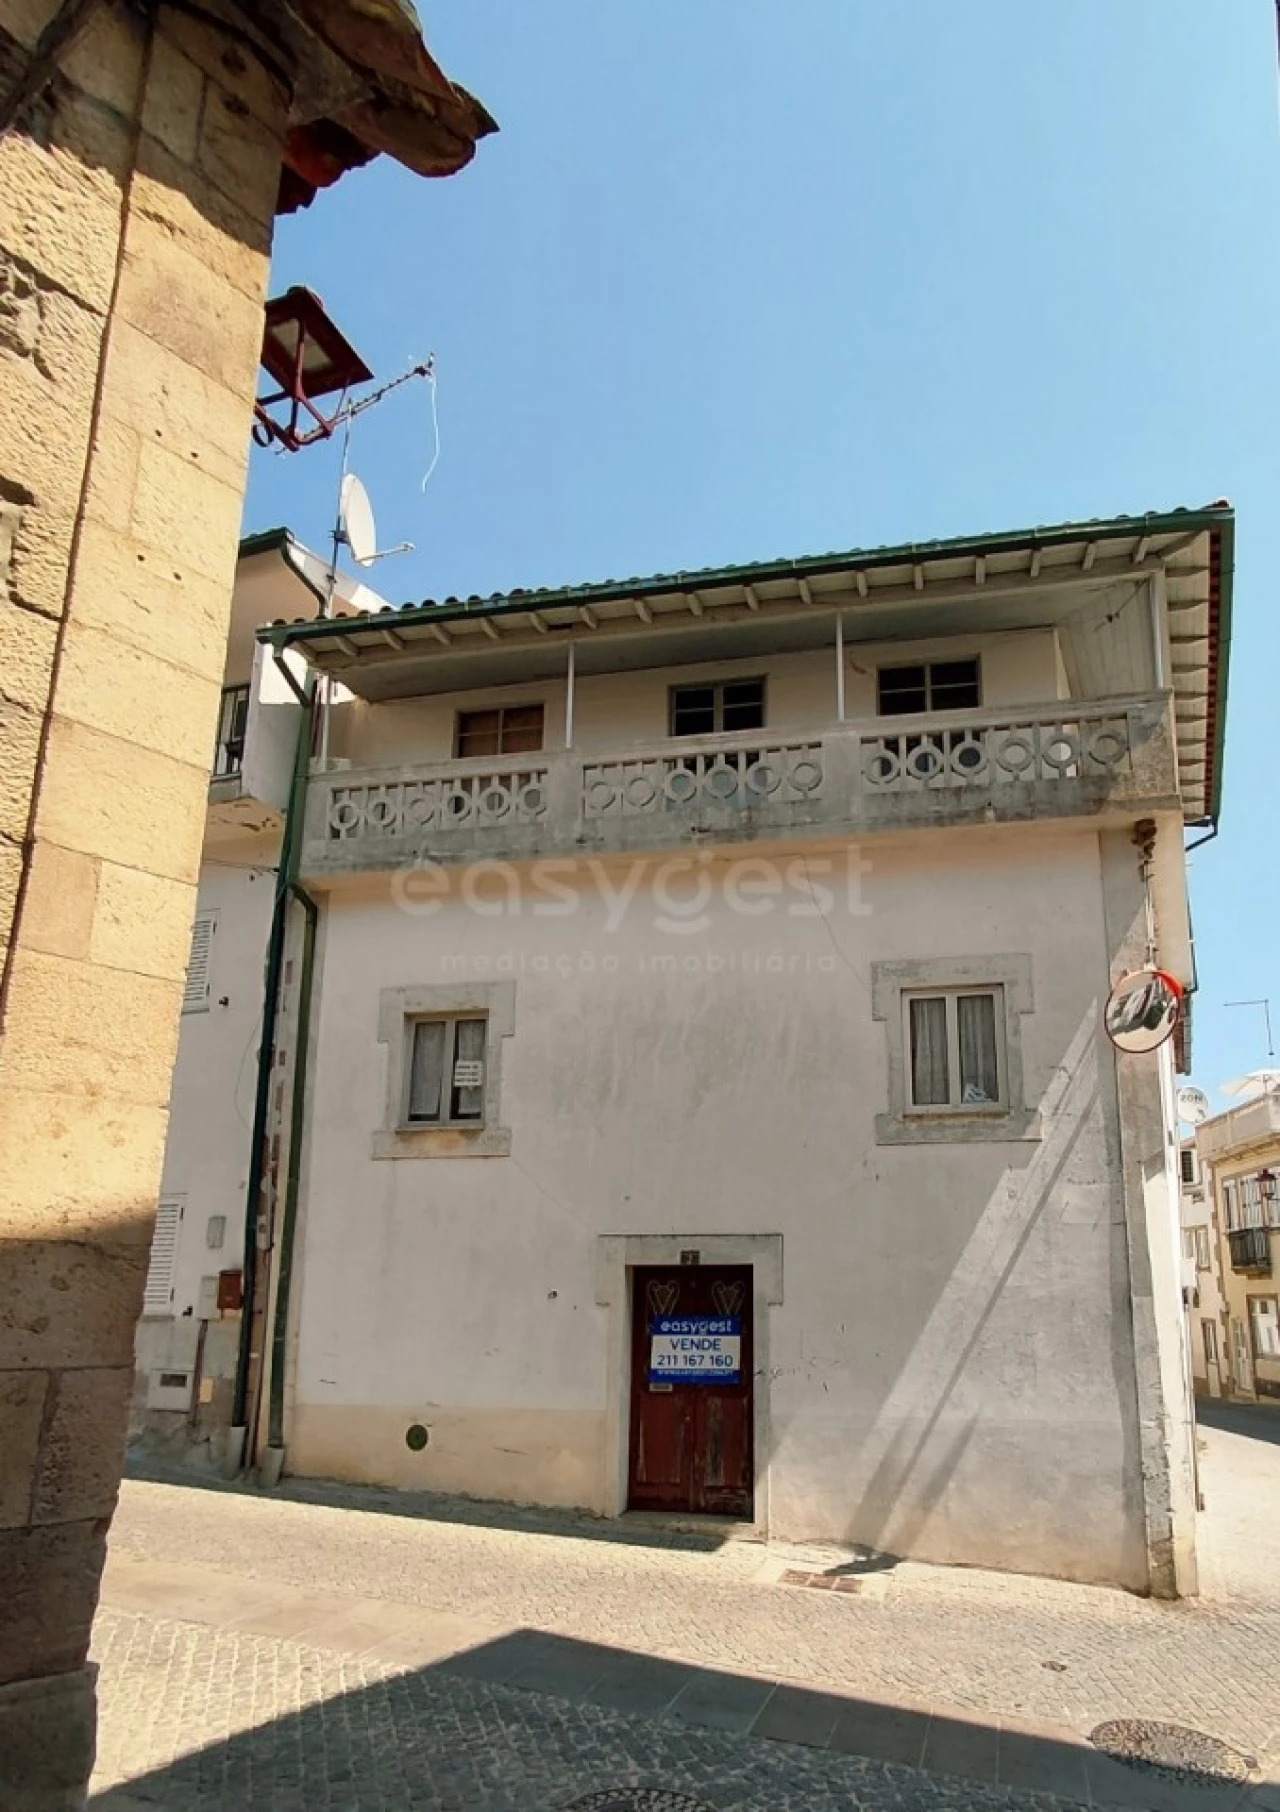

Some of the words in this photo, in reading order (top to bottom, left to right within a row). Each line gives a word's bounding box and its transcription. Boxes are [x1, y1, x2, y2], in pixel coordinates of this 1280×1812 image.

[660, 1319, 732, 1335] easygest
[670, 1337, 722, 1351] VENDE
[657, 1354, 678, 1366] 211
[683, 1354, 705, 1366] 167
[710, 1354, 733, 1366] 160
